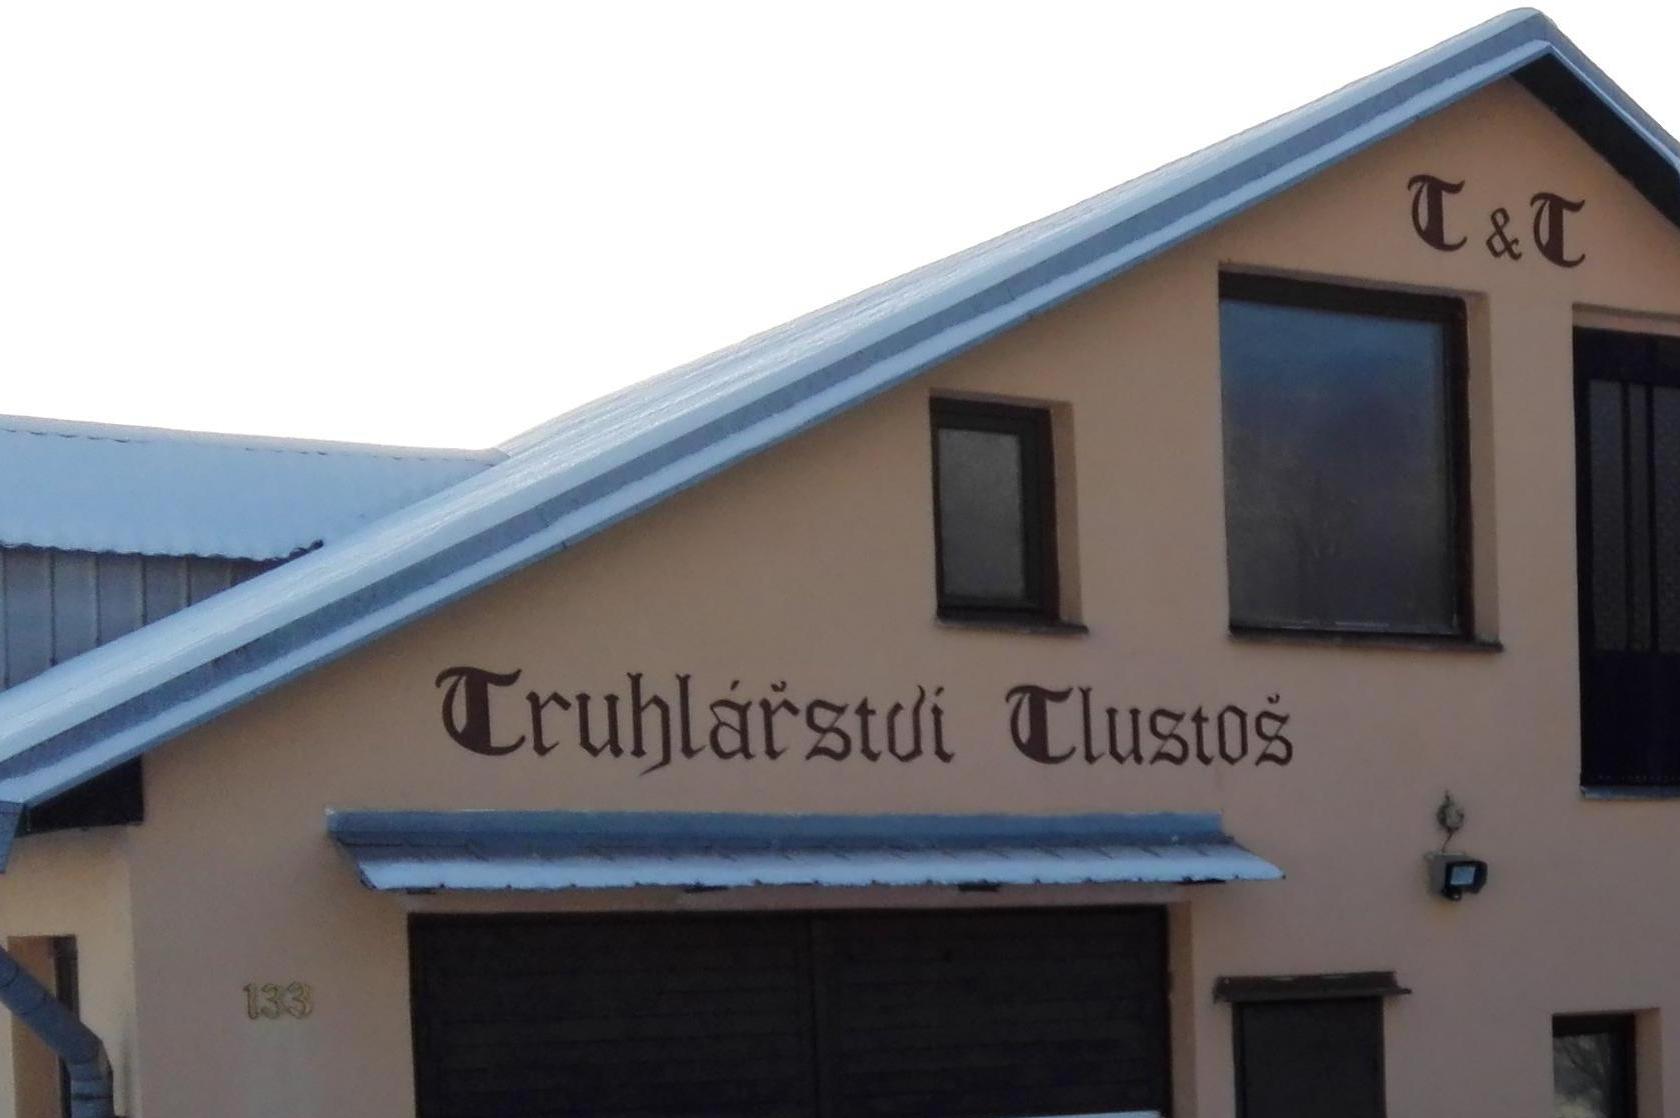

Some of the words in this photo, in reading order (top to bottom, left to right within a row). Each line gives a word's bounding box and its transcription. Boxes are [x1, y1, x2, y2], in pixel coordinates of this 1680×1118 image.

[436, 665, 956, 776] Truhlářství
[1005, 684, 1295, 769] Tlustoš
[243, 980, 314, 1020] 133
